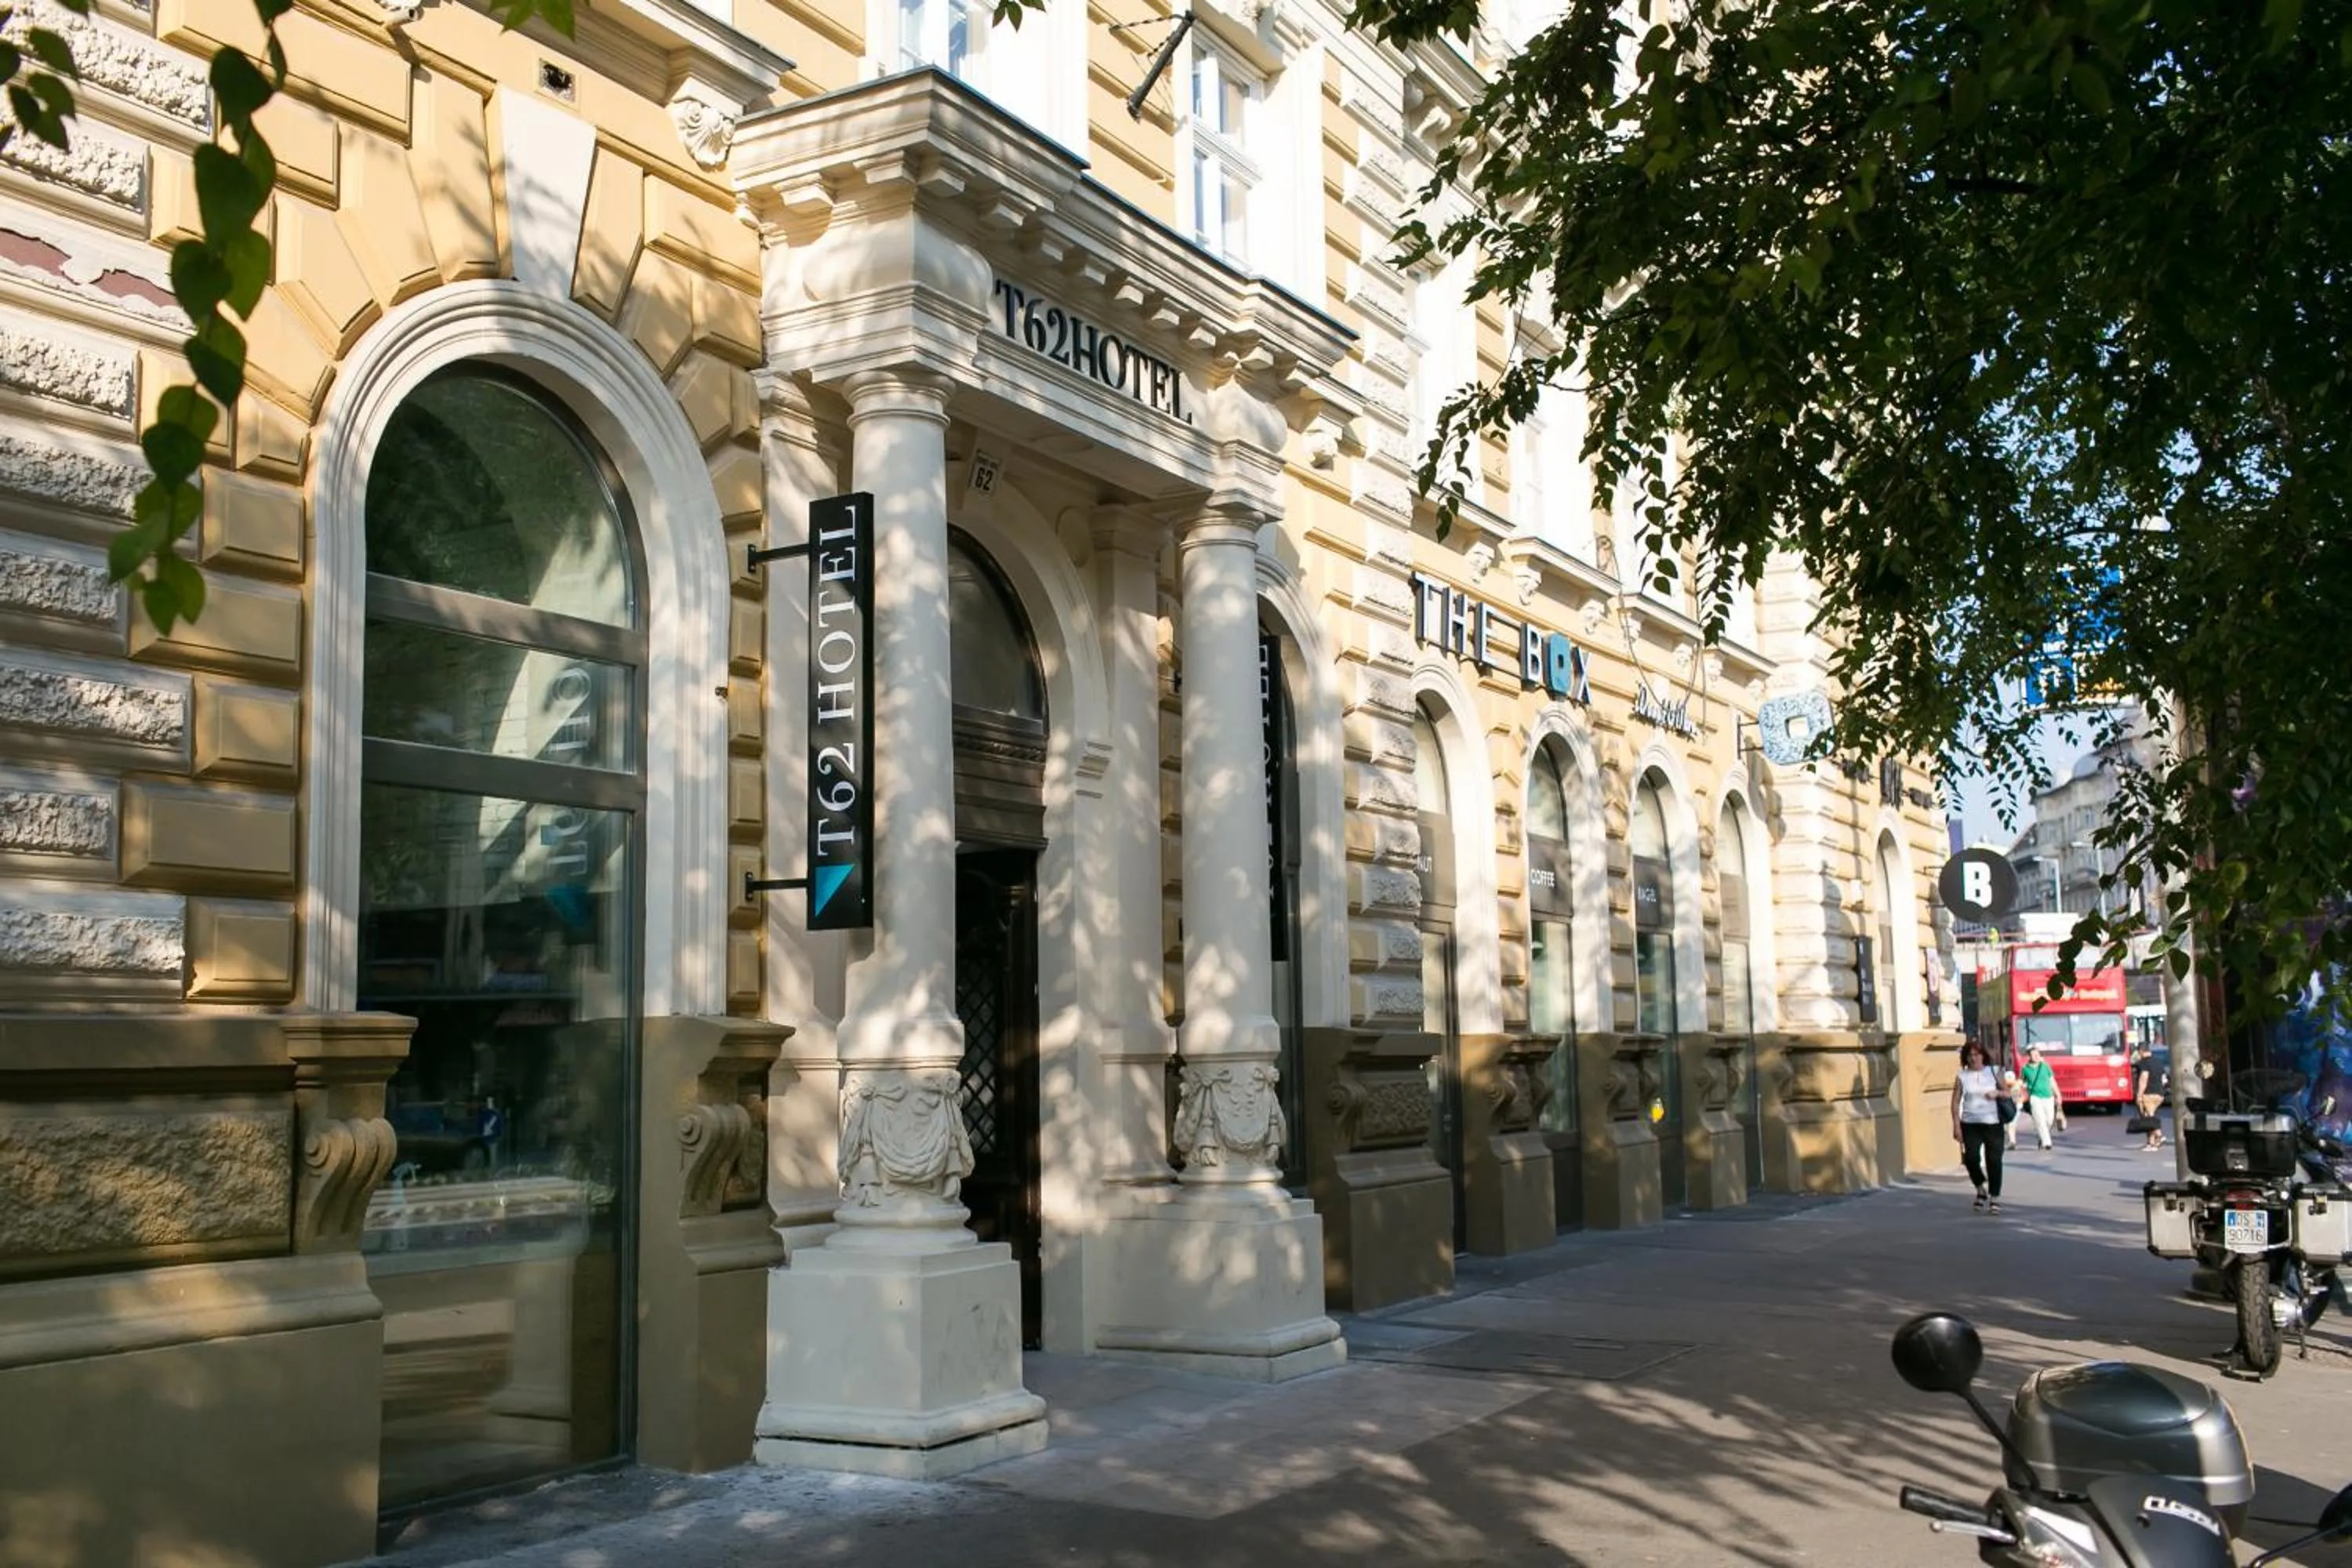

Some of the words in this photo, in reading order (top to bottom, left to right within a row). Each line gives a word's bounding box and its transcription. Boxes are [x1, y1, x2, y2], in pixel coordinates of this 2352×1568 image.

[975, 467, 993, 491] 62
[817, 505, 857, 724] HOTEL
[1413, 571, 1499, 666] THE
[1519, 622, 1592, 703] BOX
[816, 742, 855, 856] T62
[1417, 855, 1432, 873] NUT
[1530, 868, 1555, 887] COFFEE
